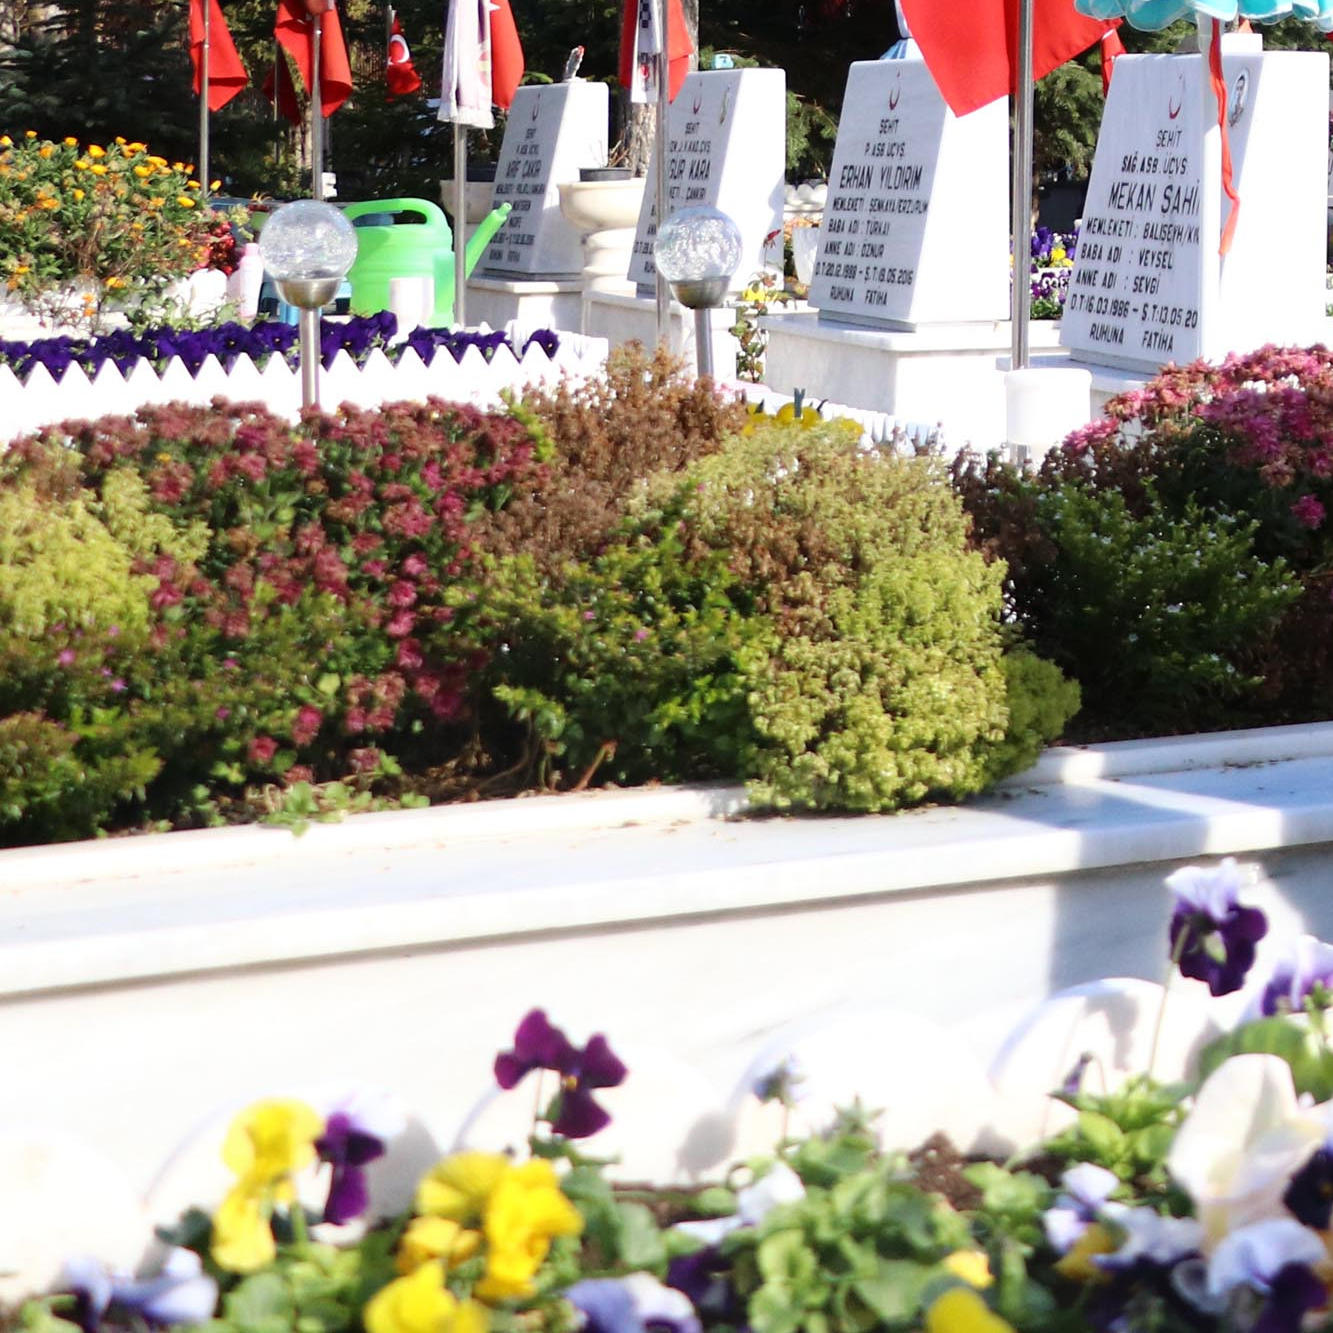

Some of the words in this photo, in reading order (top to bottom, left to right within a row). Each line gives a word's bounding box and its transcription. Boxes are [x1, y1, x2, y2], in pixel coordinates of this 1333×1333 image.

[688, 159, 711, 180] KARA
[840, 164, 873, 189] ERHAN
[880, 165, 922, 190] YILDIRIM
[1108, 181, 1157, 211] MEKAN
[1160, 178, 1200, 219] ŞAHİ
[828, 217, 845, 234] BABA
[824, 240, 842, 256] ANNE
[1081, 243, 1103, 261] BABA
[1107, 246, 1122, 264] ADI
[1138, 247, 1173, 270] VEYSEL
[1076, 269, 1099, 287] ANNE
[1101, 271, 1117, 290] ADI
[1132, 272, 1161, 295] SEVGİ
[830, 285, 855, 303] RUHUNA
[865, 285, 888, 307] FATİHA
[1089, 322, 1125, 345] RUHUNA
[1141, 328, 1174, 353] FATİHA
